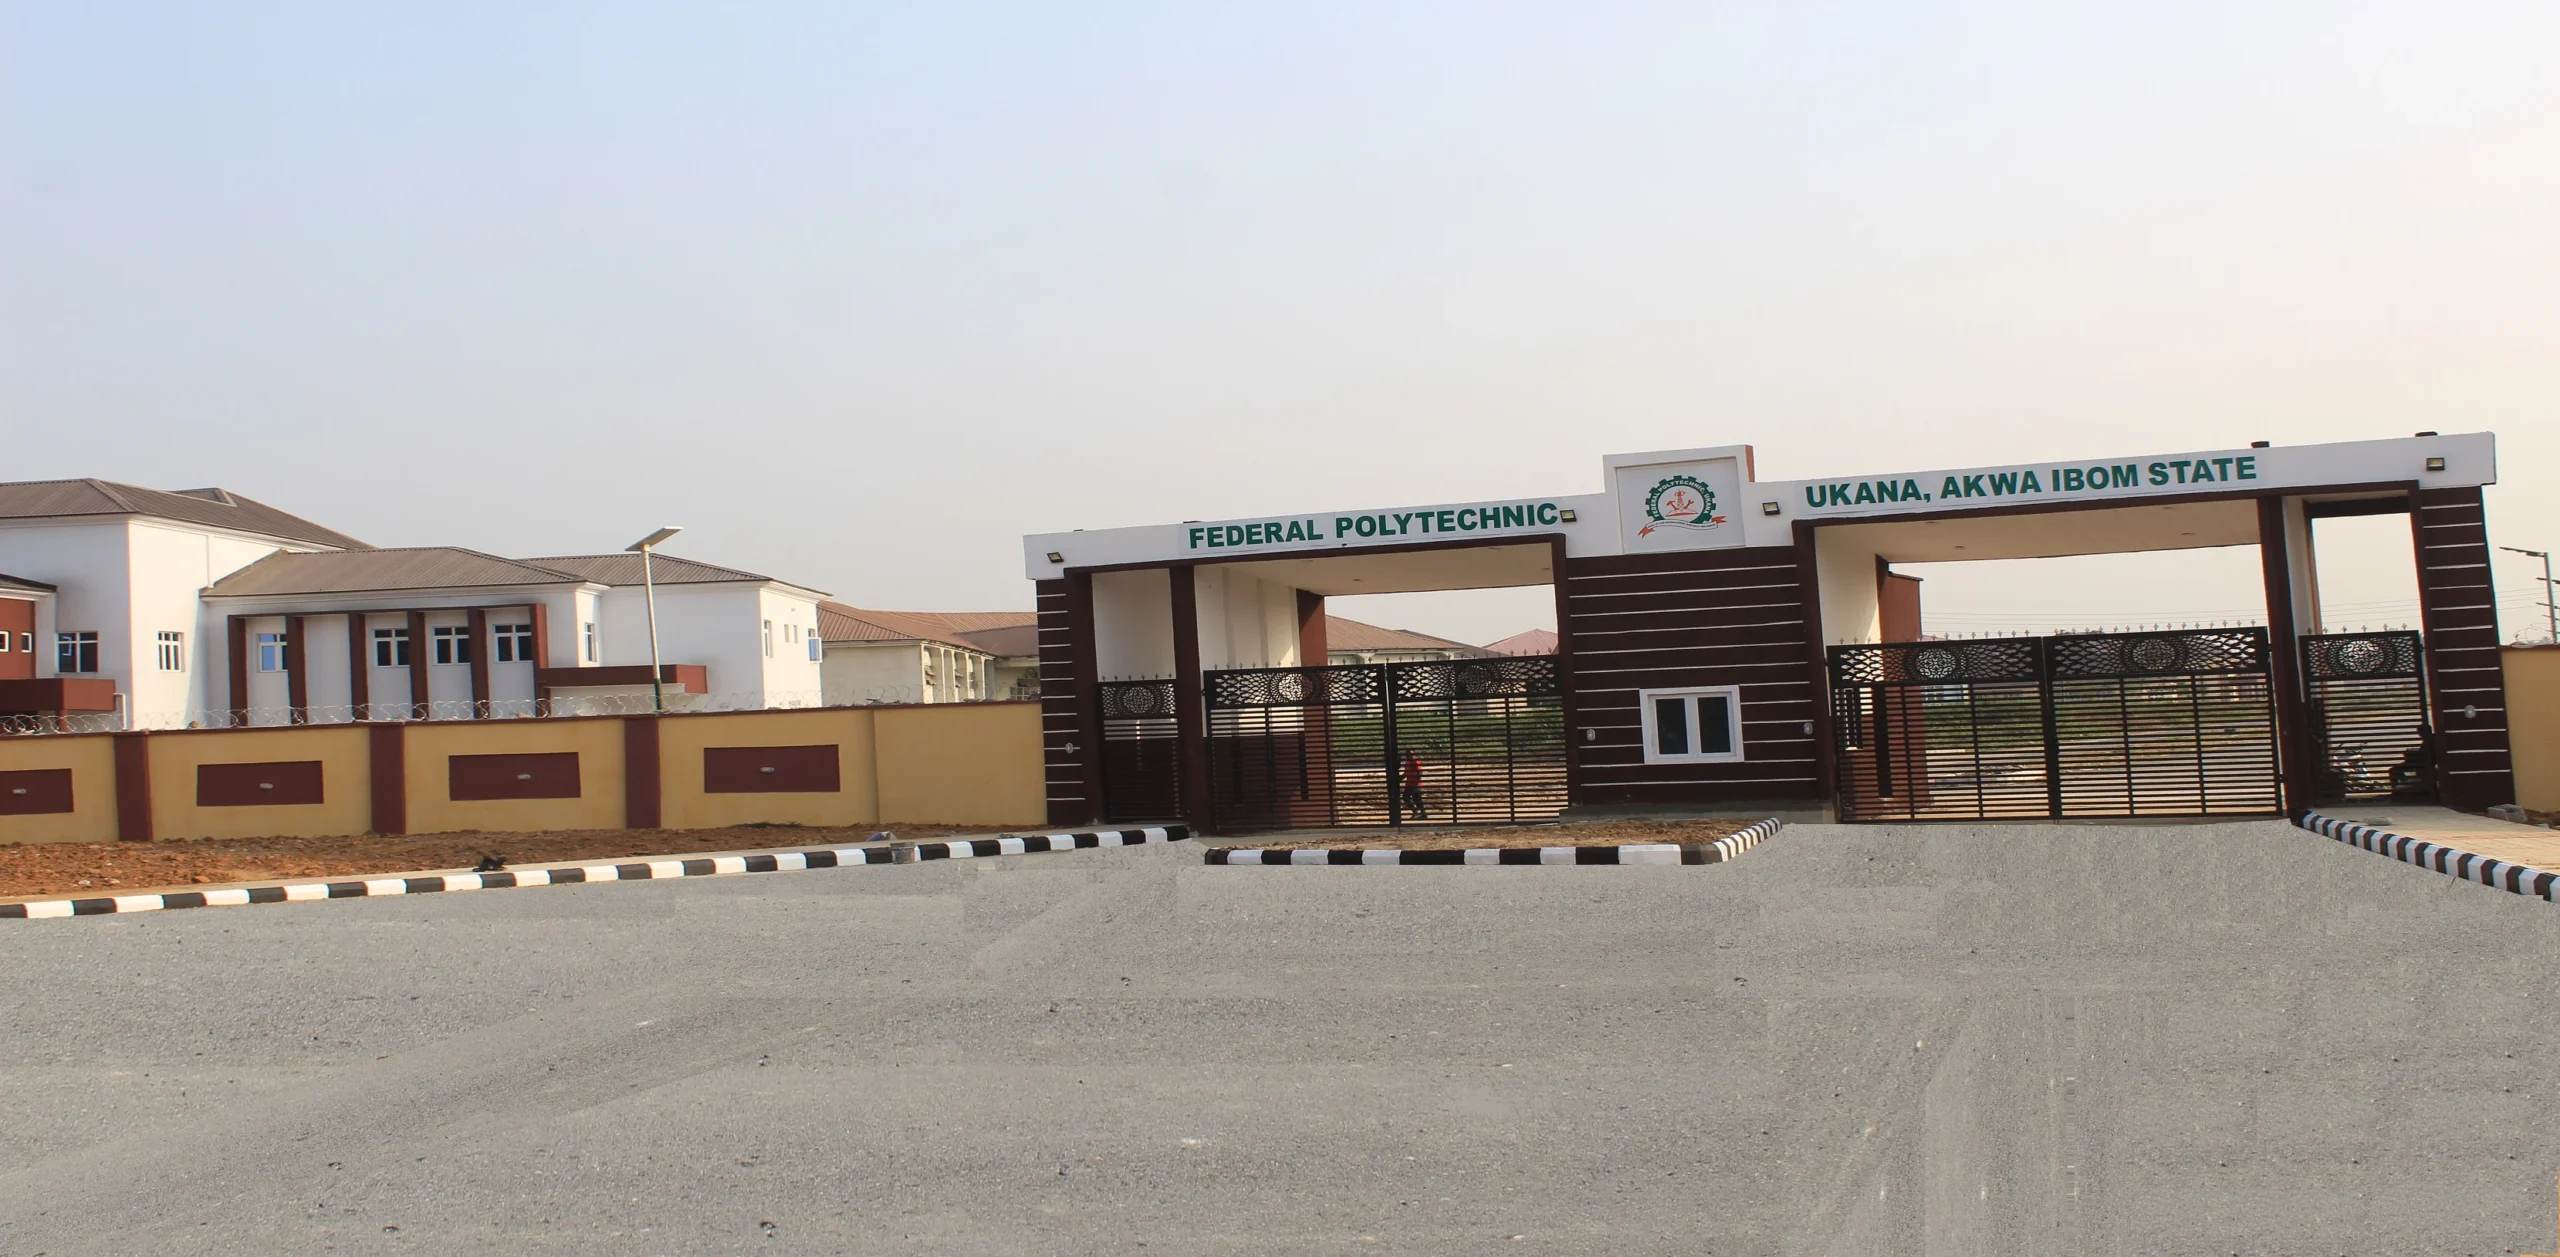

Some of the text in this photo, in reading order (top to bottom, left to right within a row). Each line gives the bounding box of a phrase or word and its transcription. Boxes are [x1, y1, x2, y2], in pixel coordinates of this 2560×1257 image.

[1806, 456, 2257, 508] UKANA, AKWA IBOM STATE
[1189, 503, 1558, 549] FEDERAL POLYTECHNIC
